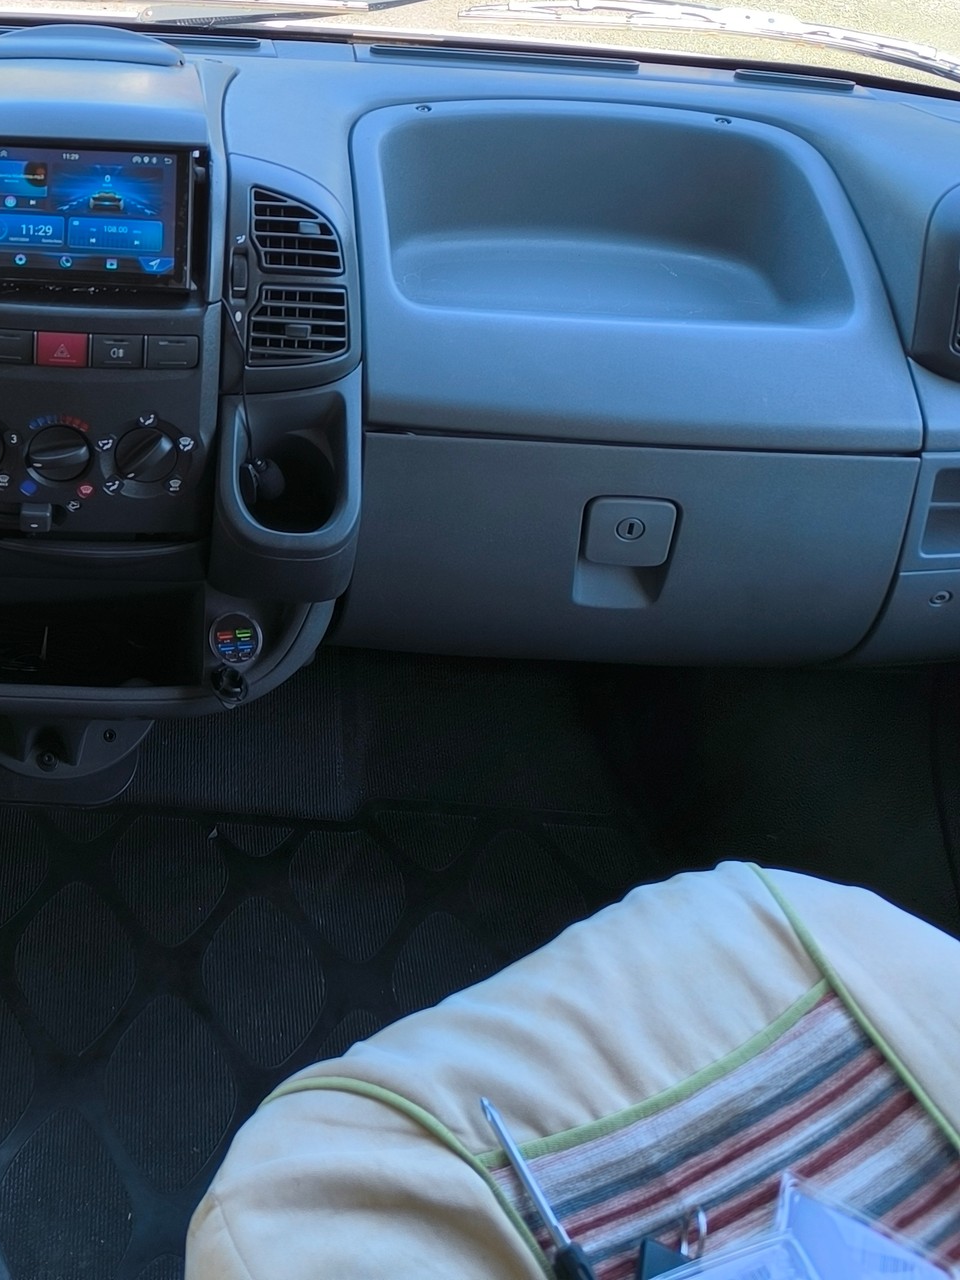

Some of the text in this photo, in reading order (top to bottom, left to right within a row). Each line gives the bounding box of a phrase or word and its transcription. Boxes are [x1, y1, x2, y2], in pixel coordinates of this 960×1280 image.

[62, 152, 80, 161] 11:29
[104, 174, 111, 183] 0
[20, 223, 53, 237] 11:29
[103, 225, 129, 235] 108.00
[10, 434, 18, 444] 3
